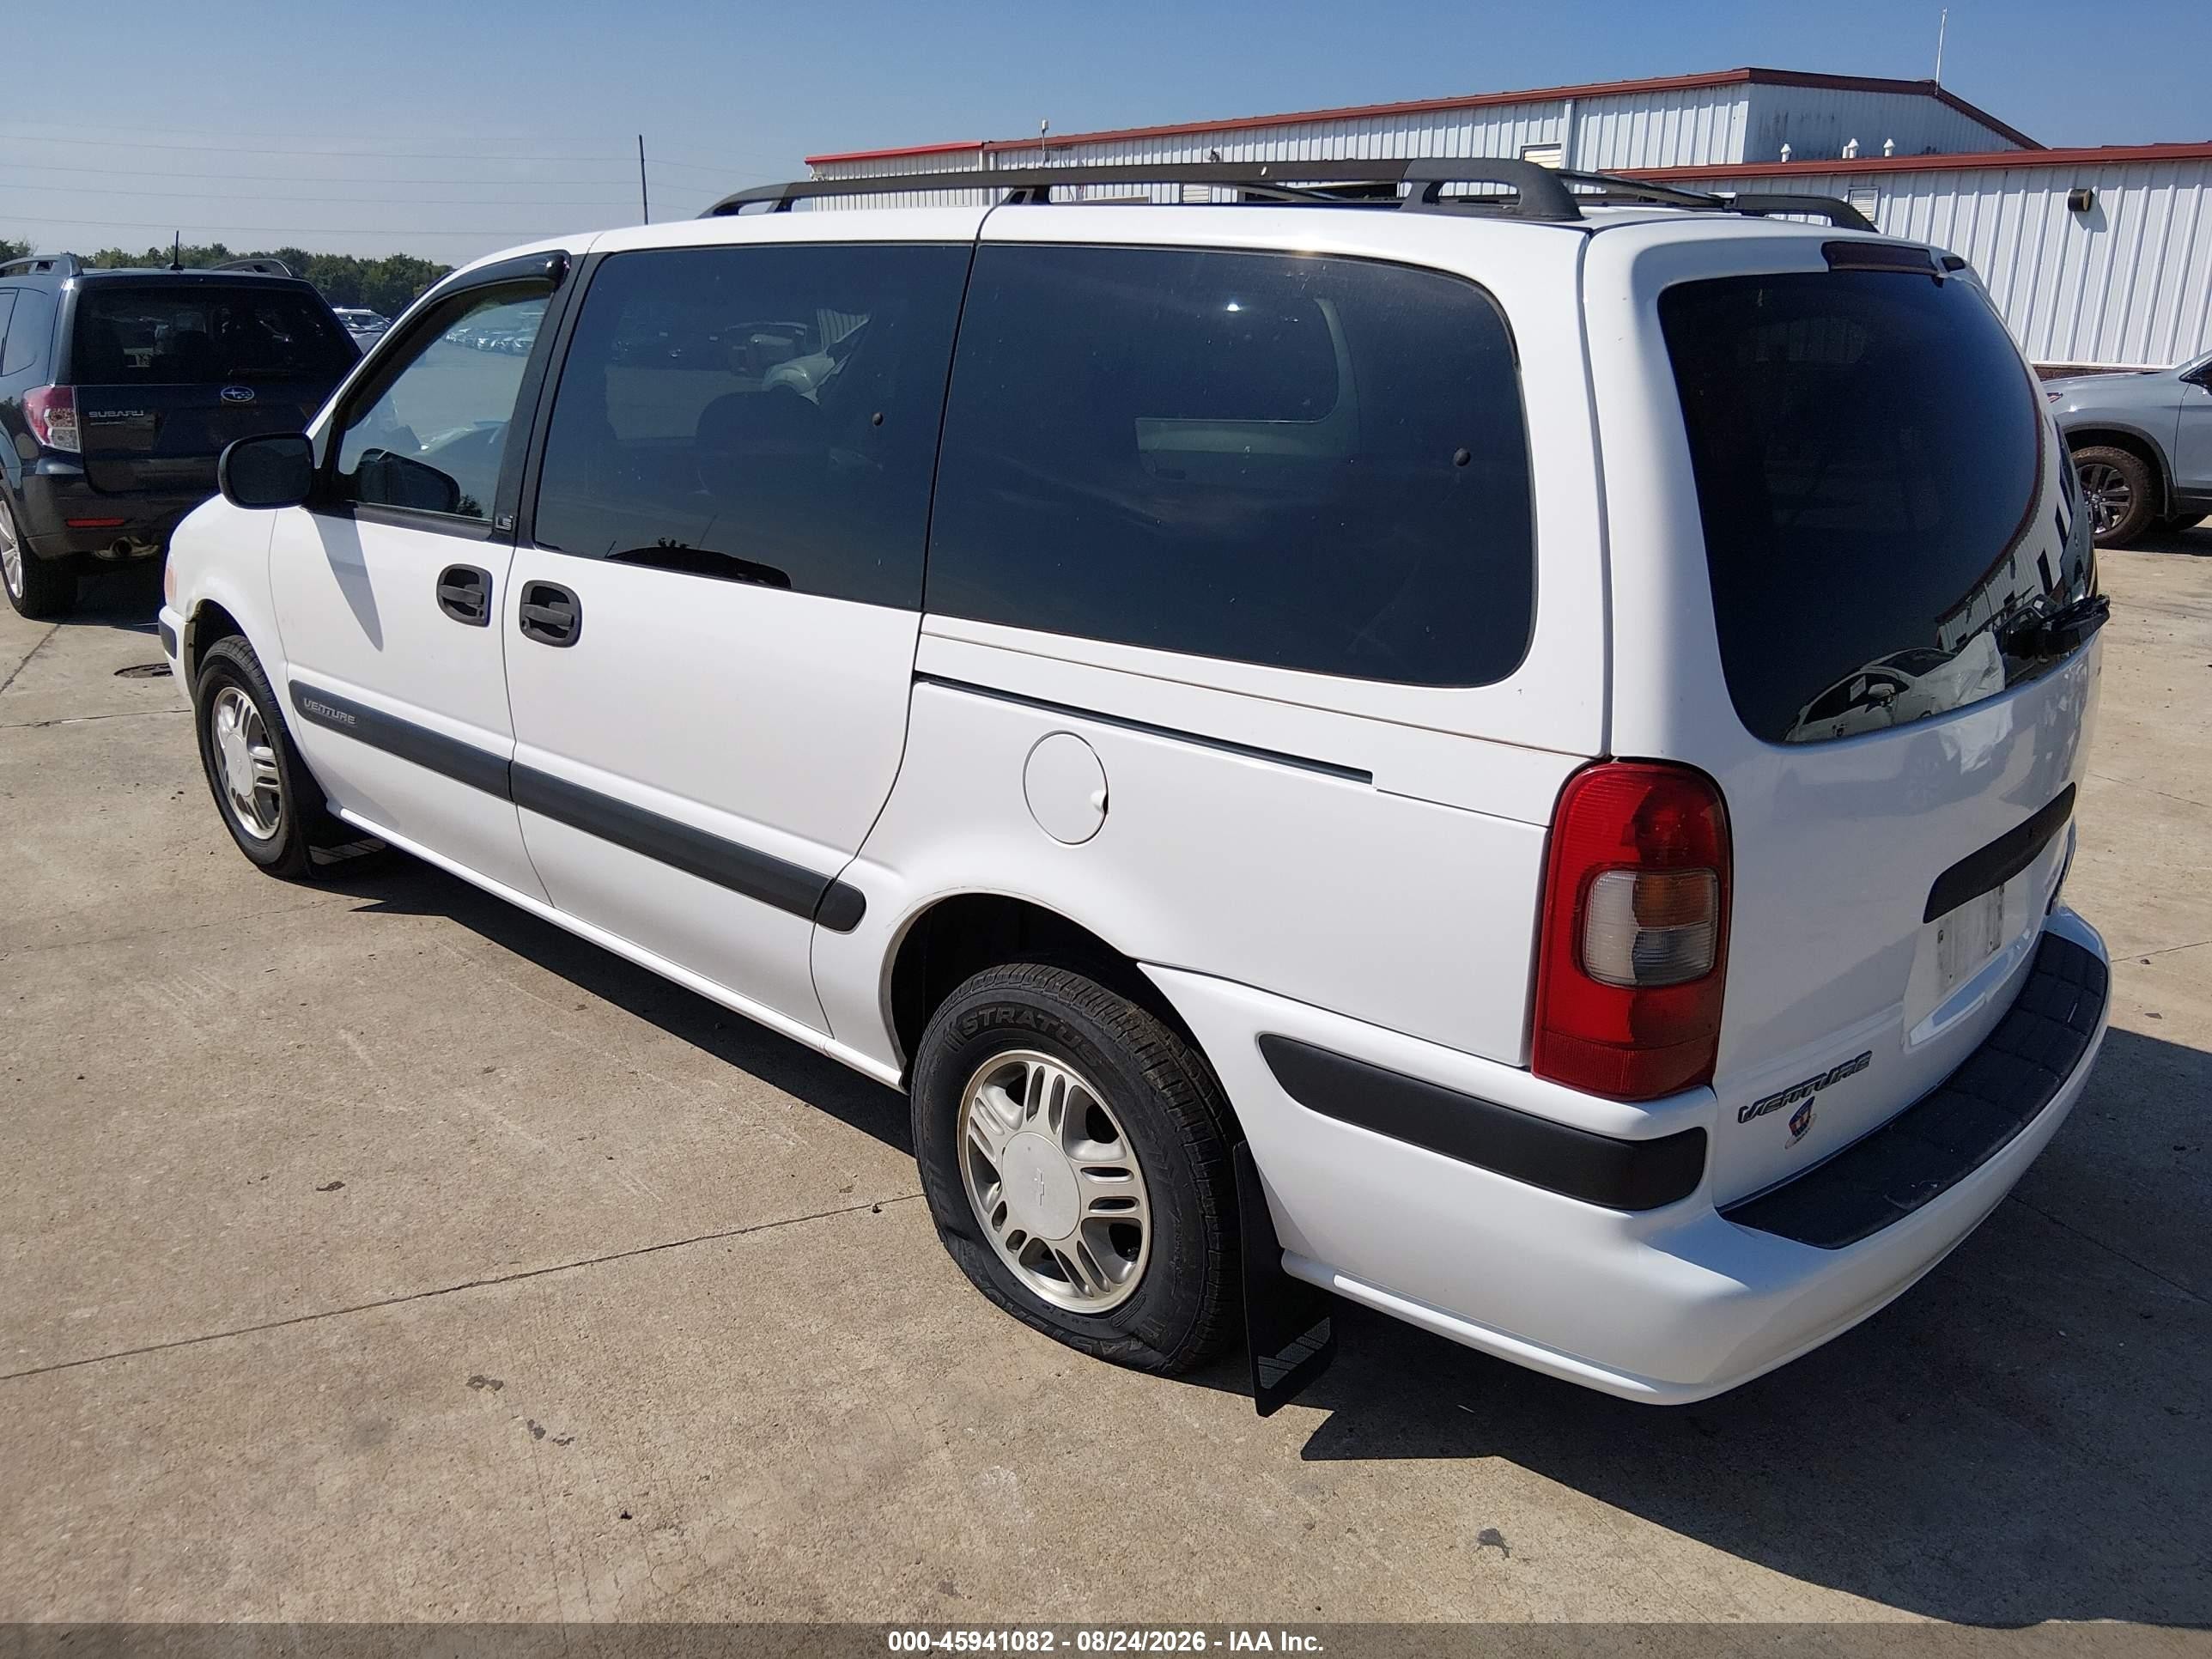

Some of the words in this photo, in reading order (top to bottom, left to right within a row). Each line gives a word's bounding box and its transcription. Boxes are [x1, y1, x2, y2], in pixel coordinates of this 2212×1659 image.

[88, 410, 144, 418] SUBARU
[495, 516, 512, 531] LS
[303, 697, 357, 725] VENTURE
[963, 1007, 1101, 1066] STRATUS
[1738, 1050, 1872, 1123] VENTURE
